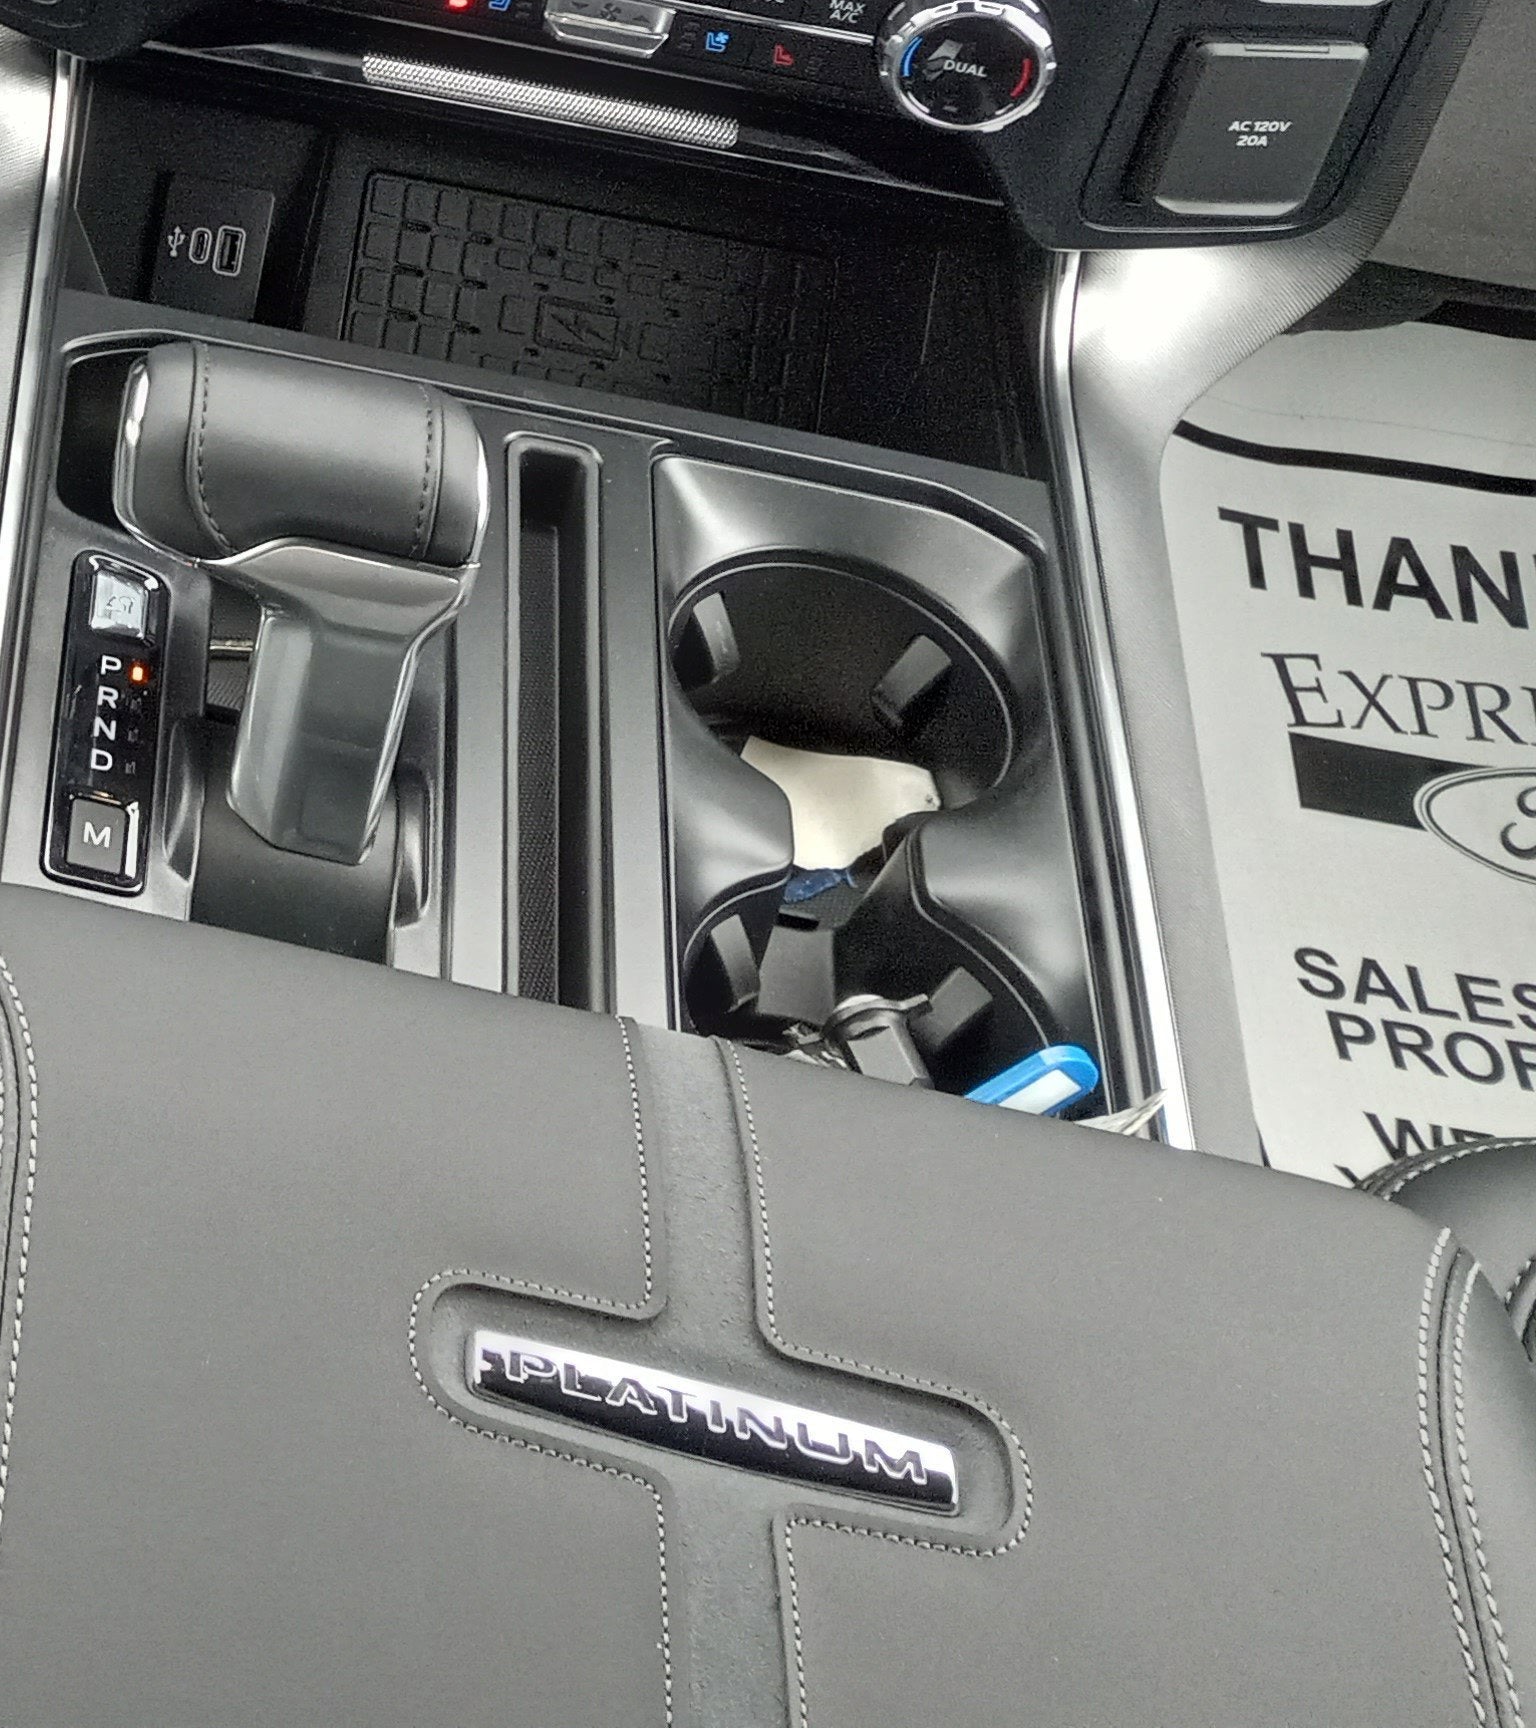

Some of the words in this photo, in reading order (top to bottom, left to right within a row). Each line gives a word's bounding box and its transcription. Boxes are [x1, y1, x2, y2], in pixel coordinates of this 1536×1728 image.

[828, 0, 868, 15] MAX
[829, 10, 859, 24] A/C
[942, 58, 988, 78] DUAL
[1228, 121, 1250, 132] AC
[1235, 134, 1269, 147] 20A
[1217, 505, 1536, 631] THAN
[1260, 651, 1536, 747] EXPR
[83, 820, 112, 849] M
[504, 1349, 927, 1486] PLATINUM
